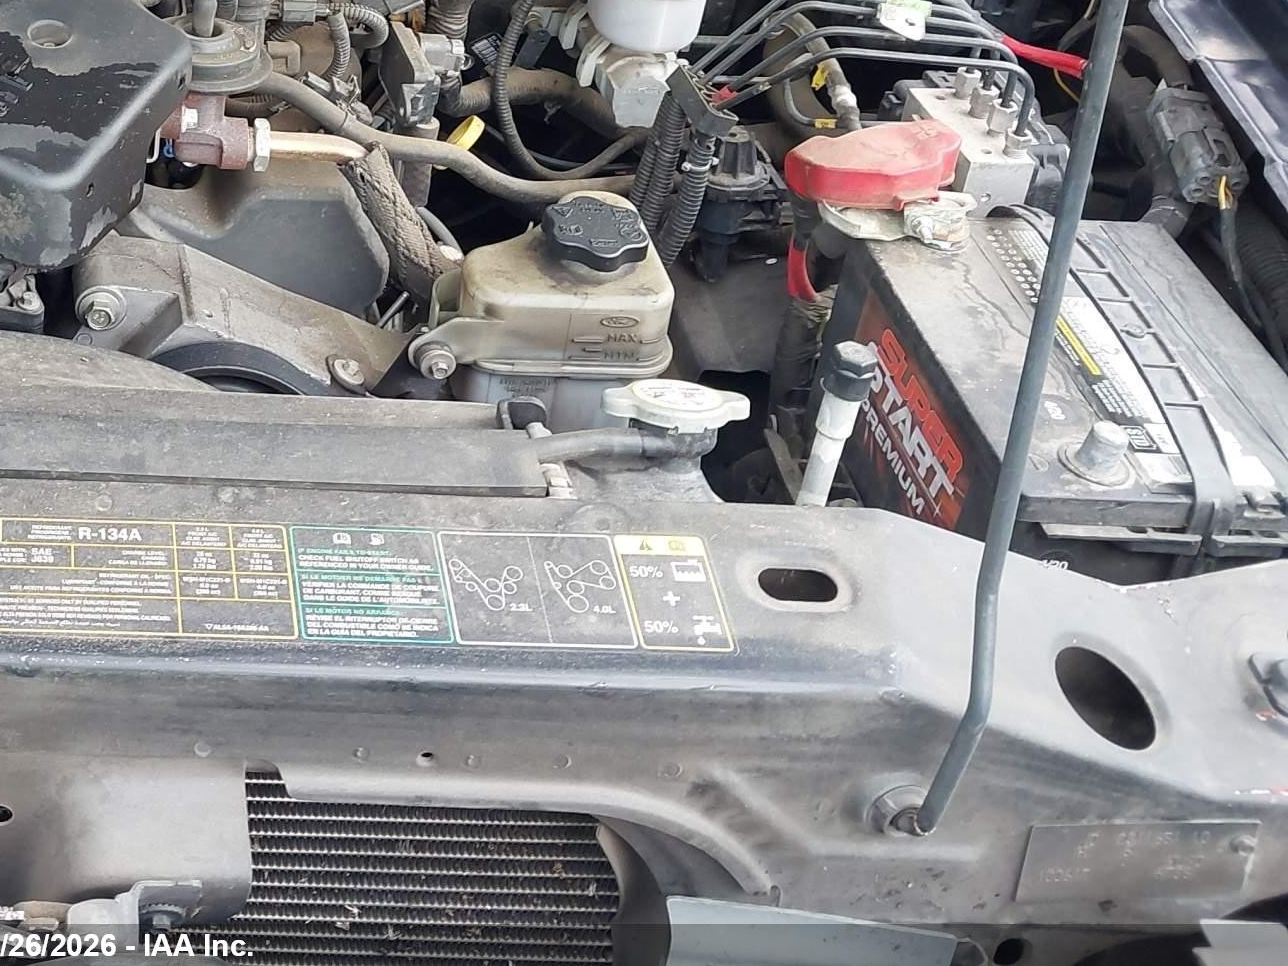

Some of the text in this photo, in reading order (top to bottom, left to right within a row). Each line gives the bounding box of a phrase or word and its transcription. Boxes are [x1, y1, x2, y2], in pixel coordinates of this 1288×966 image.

[607, 334, 638, 343] MAX
[877, 329, 963, 482] SUPER
[78, 527, 142, 541] R-134A
[31, 547, 53, 555] SAE
[299, 561, 348, 569] REFERENCED
[630, 565, 663, 578] 50%
[510, 603, 533, 612] 2.3L
[593, 605, 616, 614] 4.0L
[644, 621, 678, 634] 50%
